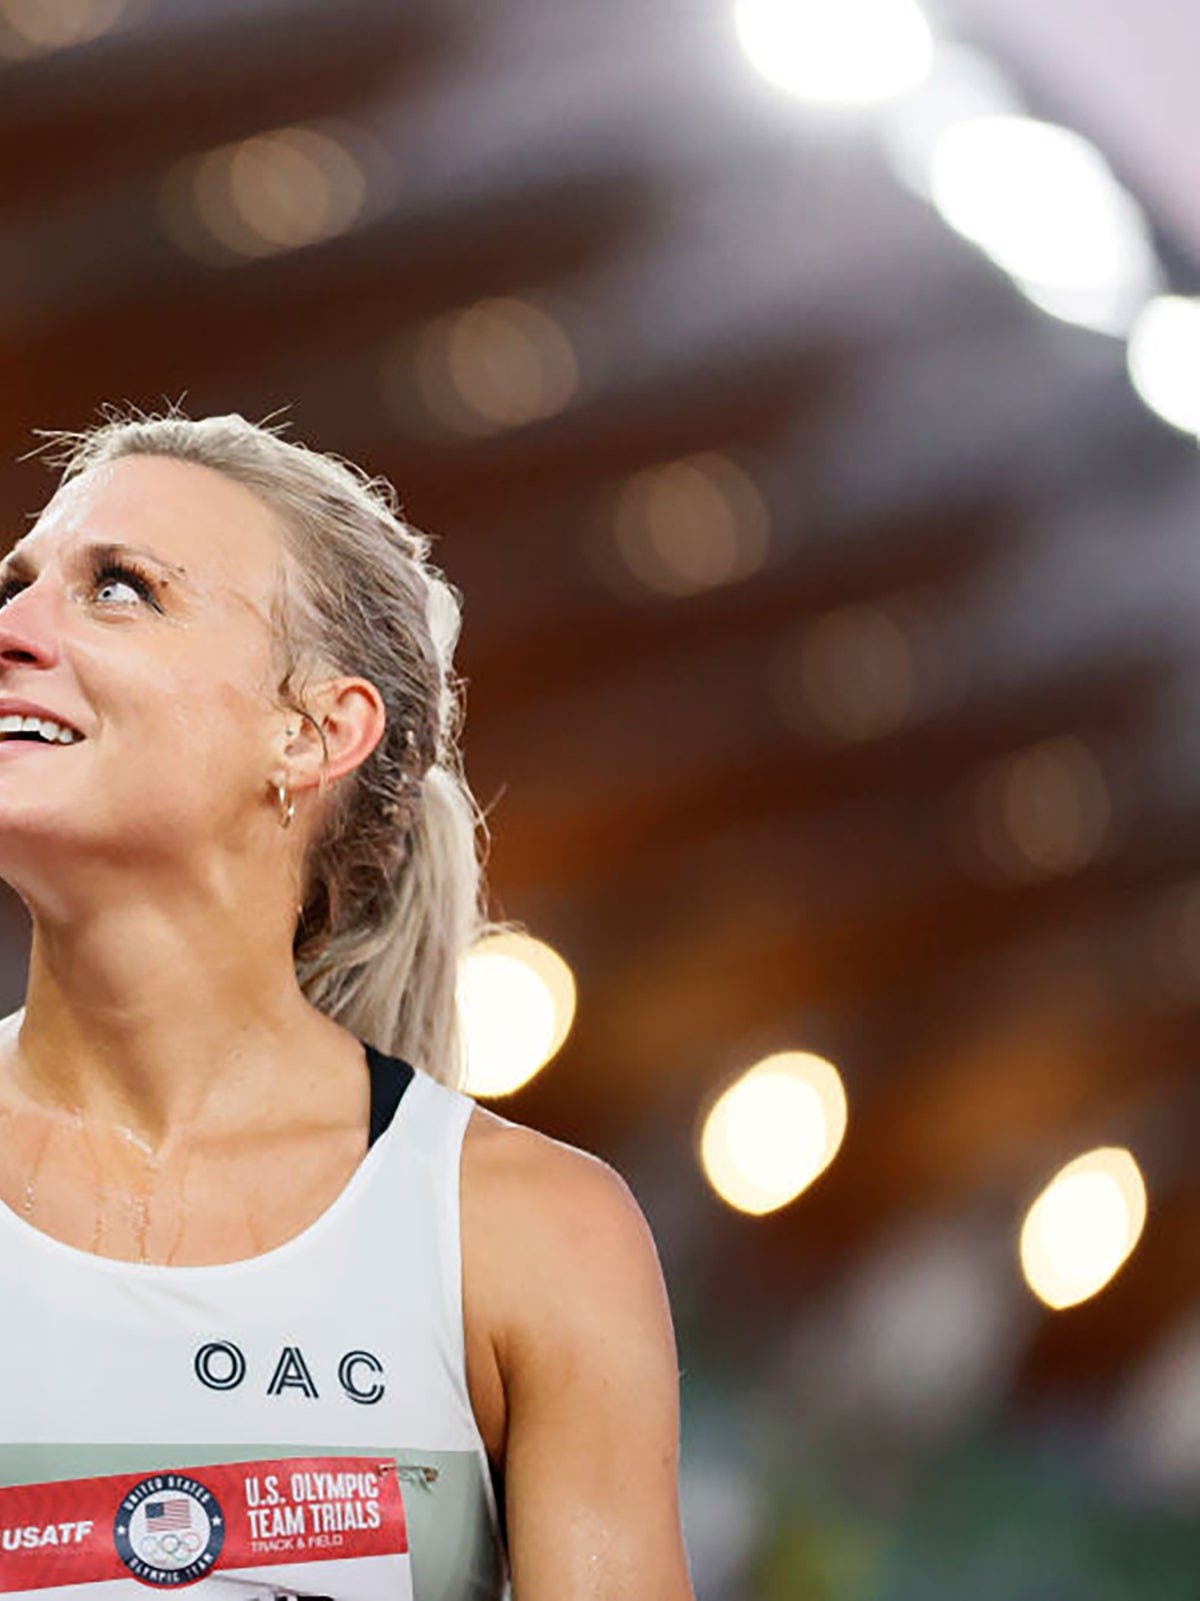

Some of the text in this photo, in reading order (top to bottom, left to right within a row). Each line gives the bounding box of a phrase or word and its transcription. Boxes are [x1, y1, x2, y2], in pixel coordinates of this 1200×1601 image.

[194, 1341, 385, 1405] OAC
[123, 1476, 211, 1510] UNITED STATES
[245, 1472, 379, 1506] U.S. OLYMPIC
[2, 1520, 94, 1550] USATF
[247, 1500, 381, 1538] TEAM TRIALS
[252, 1534, 343, 1552] TRACK & FIELD
